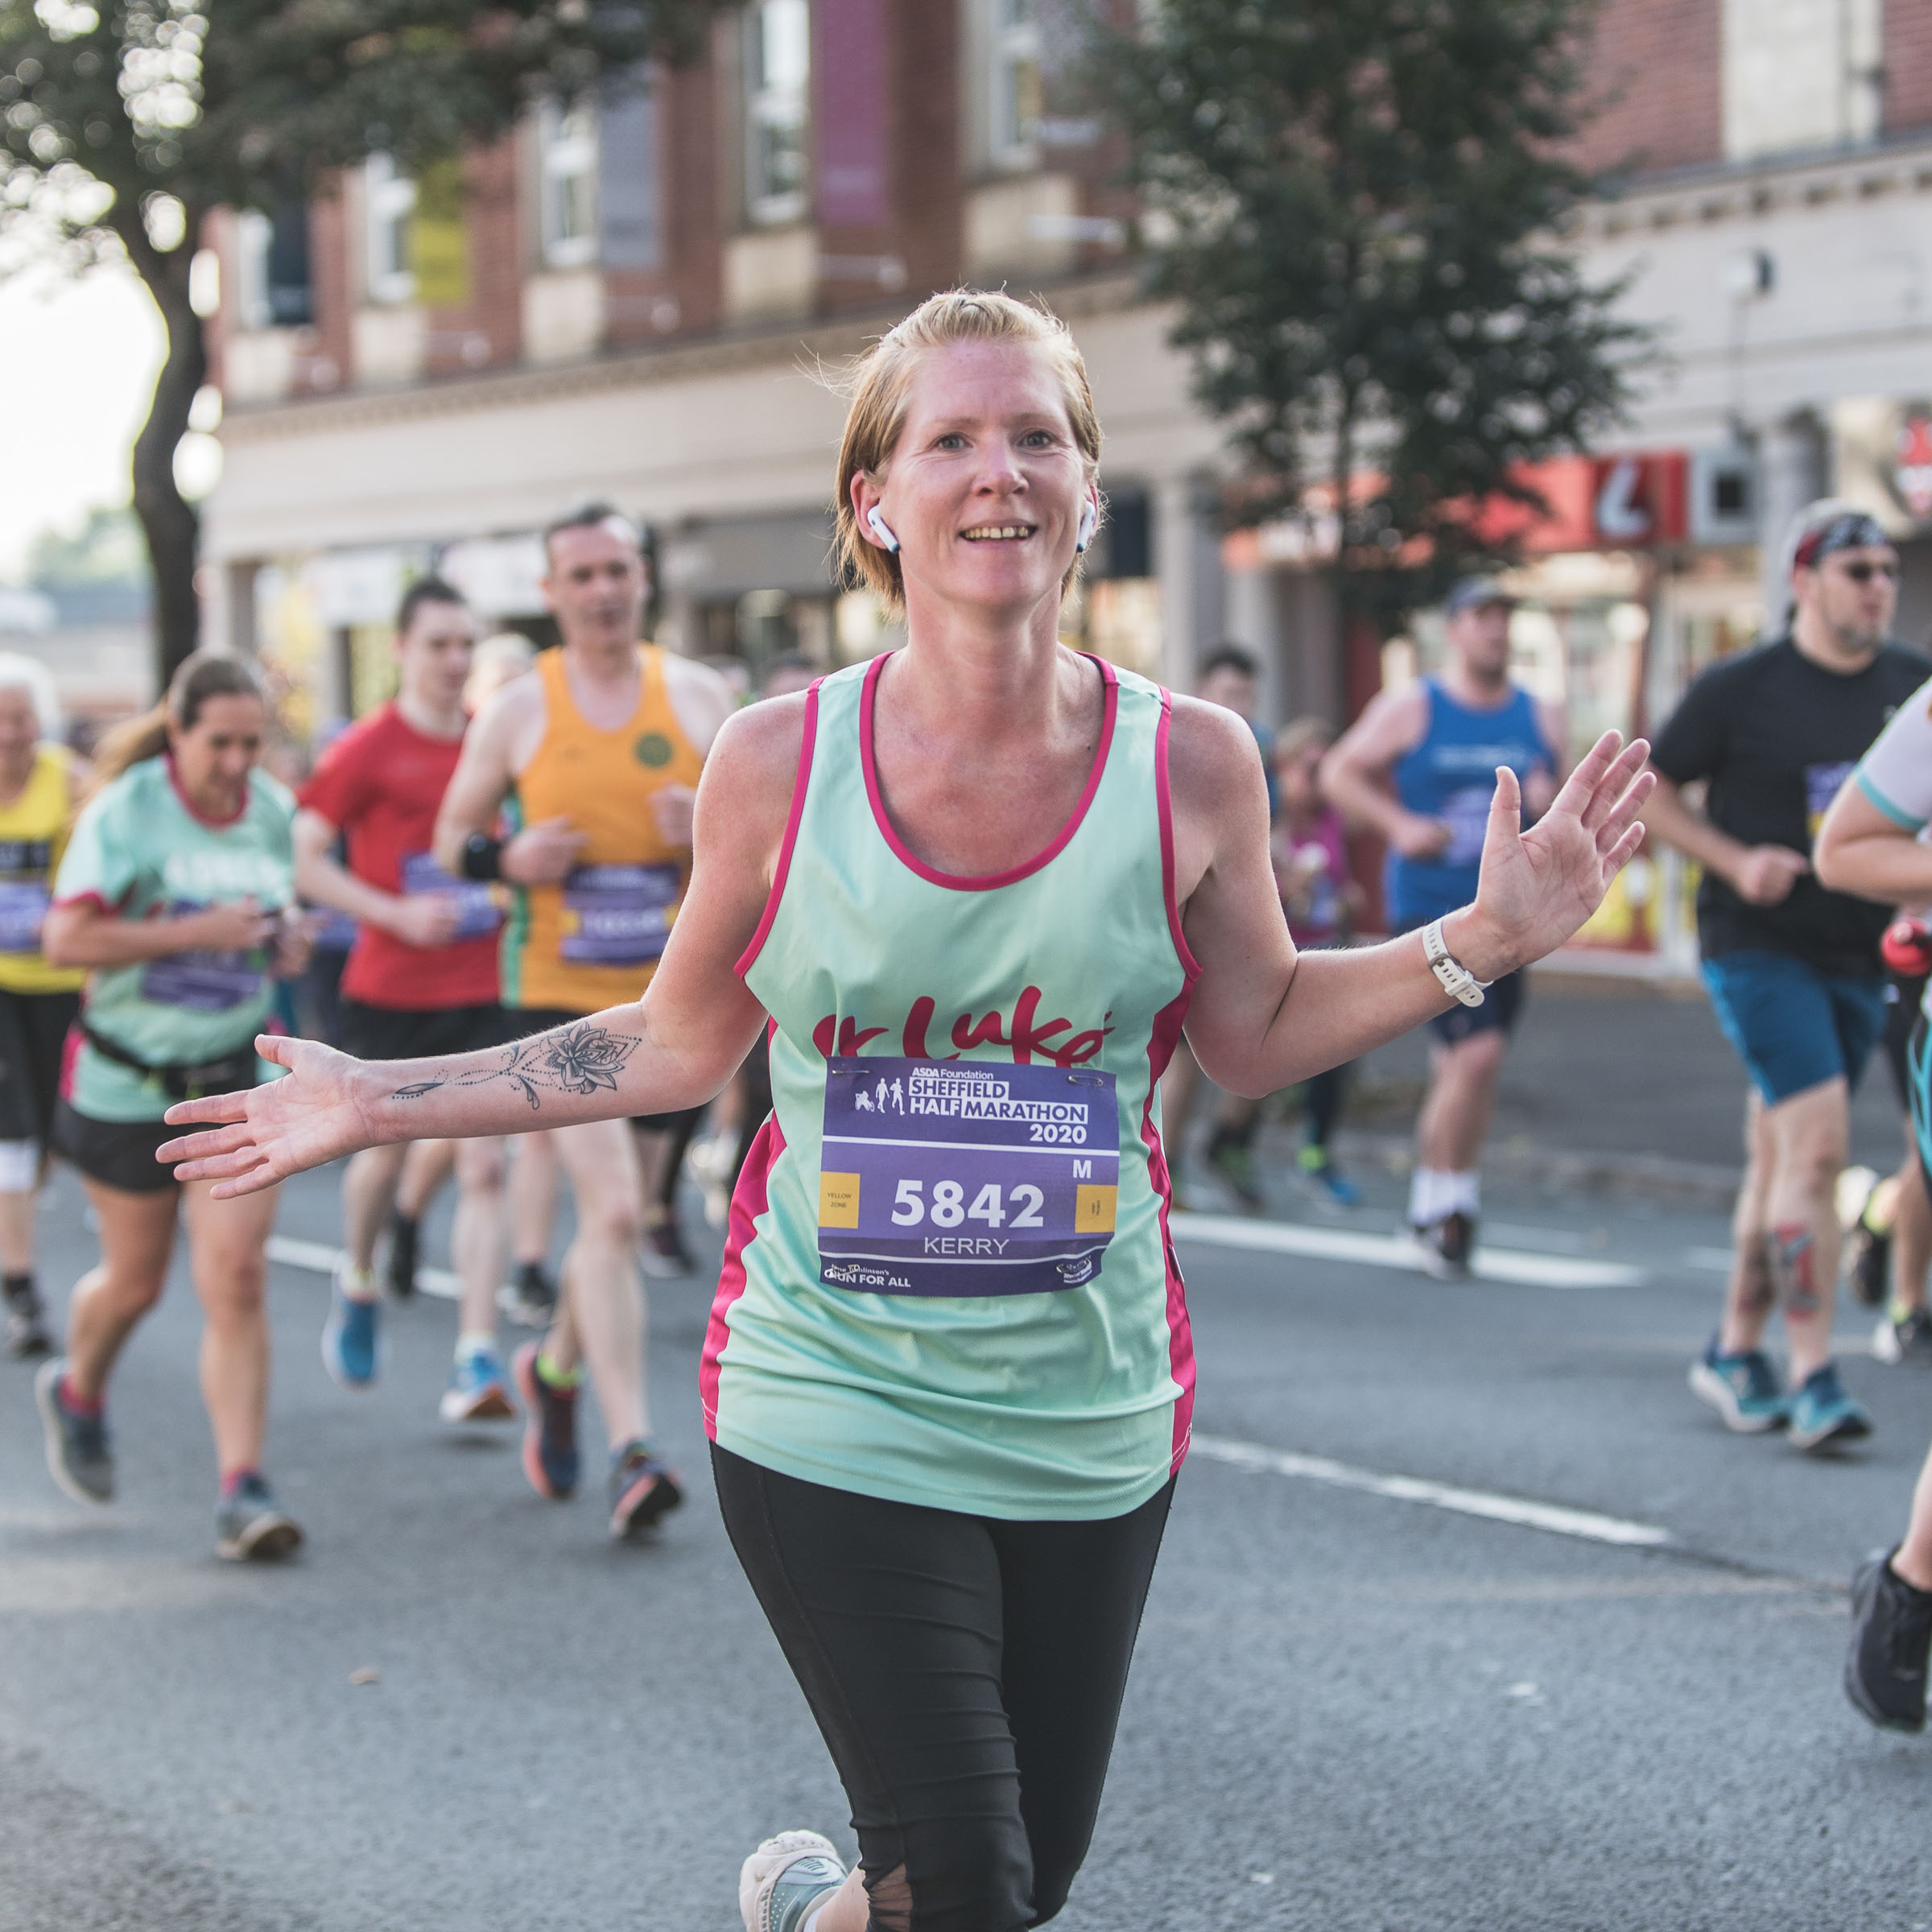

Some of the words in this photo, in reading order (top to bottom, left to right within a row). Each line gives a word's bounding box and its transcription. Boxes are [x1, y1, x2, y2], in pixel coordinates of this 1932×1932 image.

[912, 1067, 939, 1078] ASDA
[940, 1069, 993, 1080] Foundation
[911, 1080, 1006, 1098] SHEFFIELD
[910, 1098, 960, 1116] HALF
[964, 1101, 1085, 1121] MARATHON
[1030, 1124, 1087, 1144] 2020
[1073, 1159, 1092, 1179] M
[891, 1179, 1044, 1228] 5842
[924, 1237, 1009, 1255] KERRY
[860, 1274, 885, 1286] FOR
[888, 1277, 911, 1287] ALL
